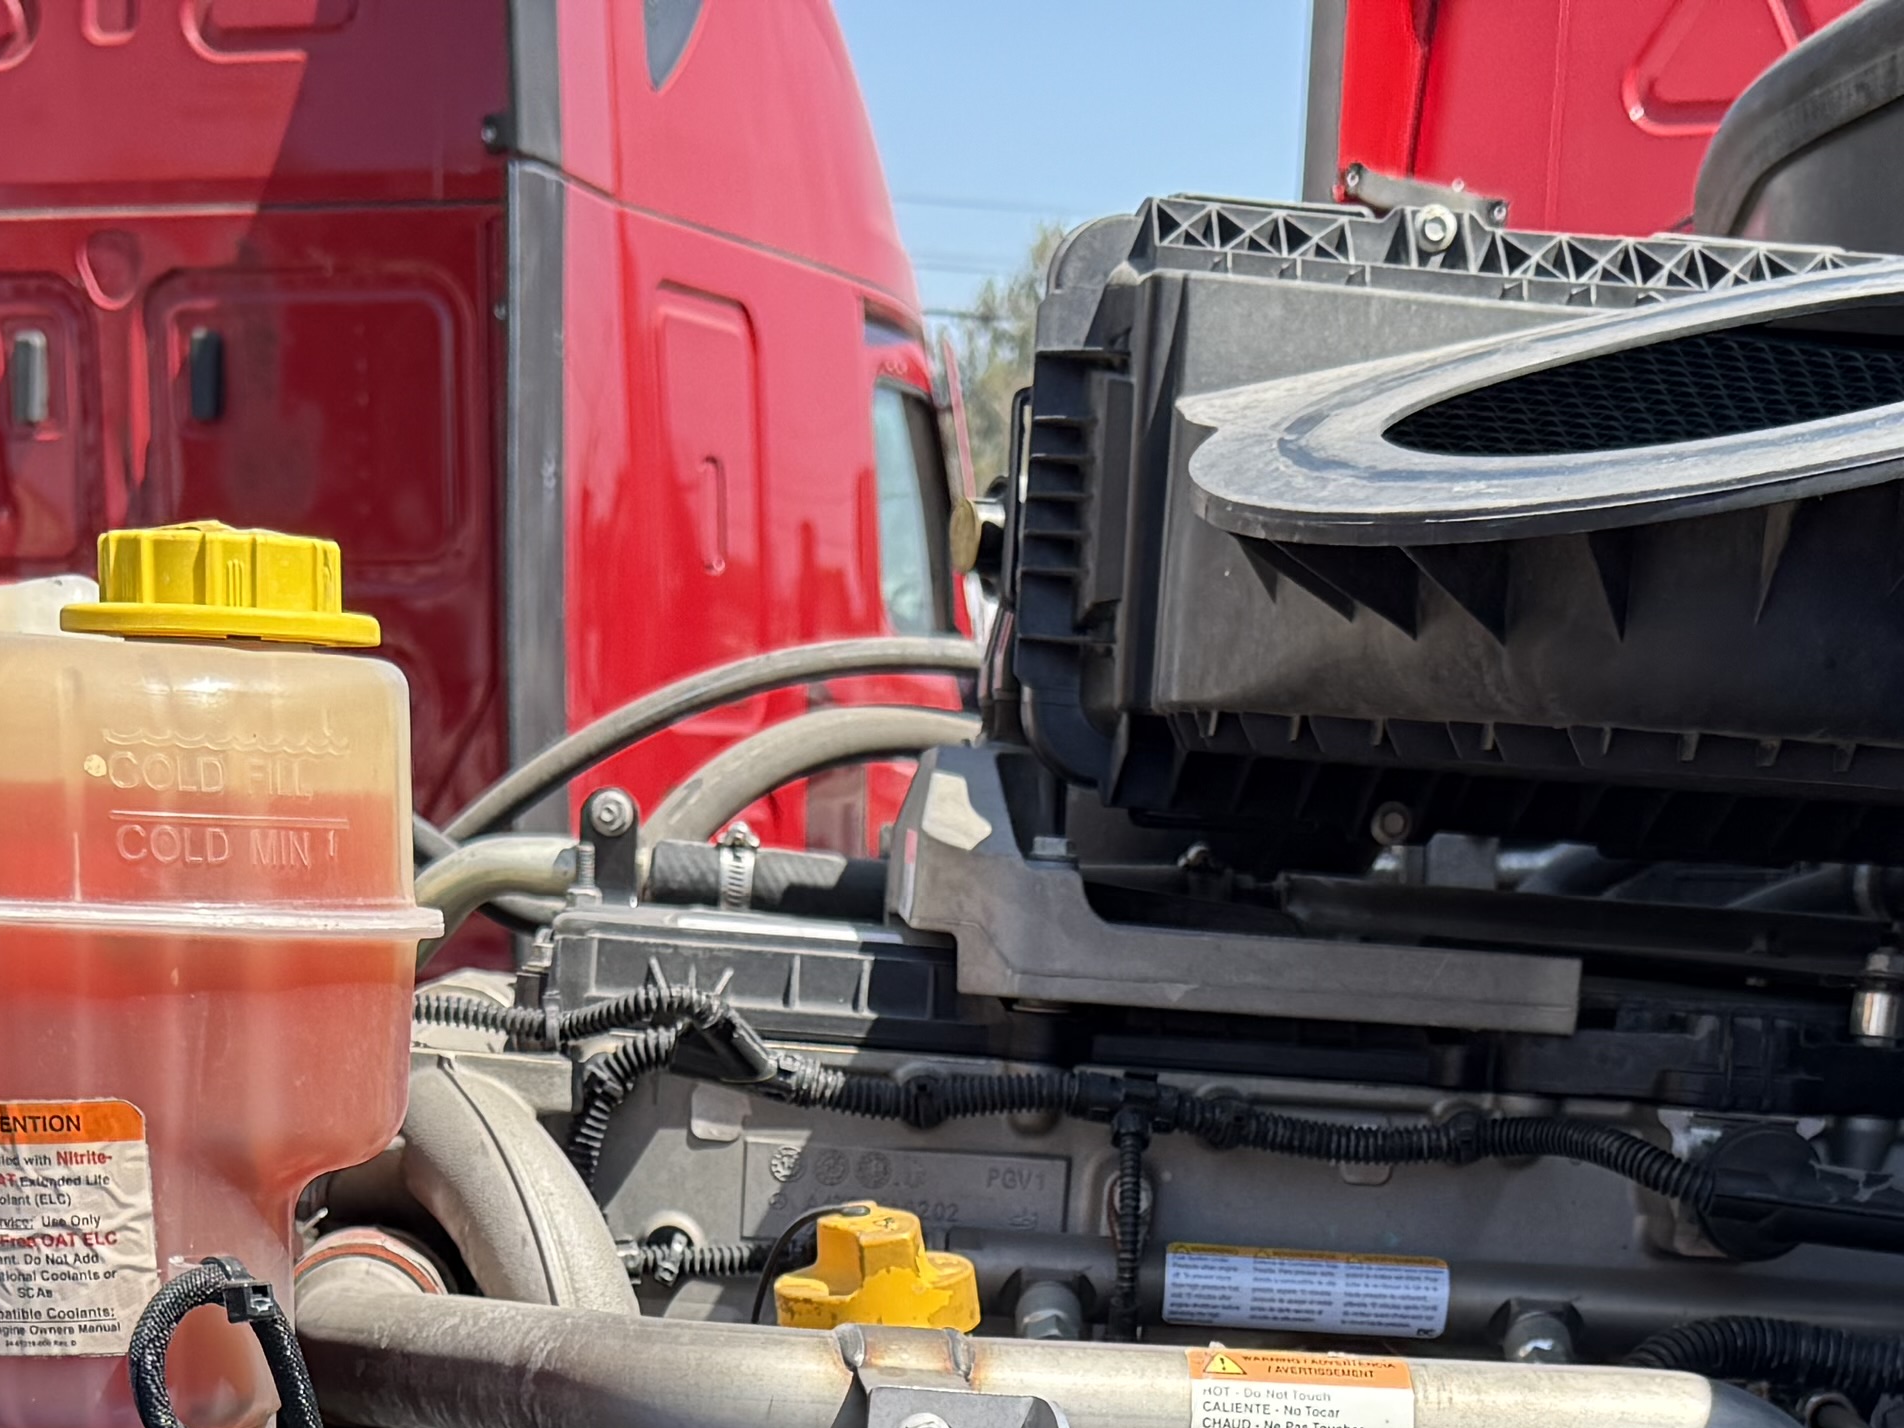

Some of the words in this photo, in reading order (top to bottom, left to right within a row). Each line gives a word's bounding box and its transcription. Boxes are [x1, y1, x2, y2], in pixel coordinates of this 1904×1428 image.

[107, 750, 225, 794] COLD
[248, 756, 313, 799] FILL
[116, 824, 229, 864] COLD
[251, 829, 311, 869] MIN
[23, 1154, 51, 1166] with
[56, 1150, 112, 1166] Nitrite-
[20, 1176, 82, 1188] Extended
[86, 1174, 110, 1186] Life
[34, 1193, 72, 1207] (ELC)
[41, 1215, 66, 1227] Use
[71, 1215, 101, 1230] Only
[41, 1233, 77, 1247] OAT
[84, 1231, 118, 1247] ELC
[24, 1253, 41, 1265] Do
[46, 1252, 70, 1266] Not
[73, 1252, 99, 1264] Add
[41, 1269, 100, 1282] Coolants
[103, 1270, 117, 1281] or
[17, 1287, 53, 1299] SCAs
[46, 1307, 115, 1320] Coolants:
[29, 1324, 75, 1335] Owners
[78, 1322, 121, 1334] Manual
[1275, 1365, 1375, 1378] AVERTISSEMENT
[1203, 1386, 1231, 1398] HOT
[1243, 1387, 1261, 1399] Do
[1265, 1388, 1289, 1400] Not
[1292, 1389, 1332, 1402] Touch
[1202, 1401, 1271, 1416] CALIENTE
[1284, 1405, 1302, 1418] No
[1305, 1406, 1340, 1419] Tocar
